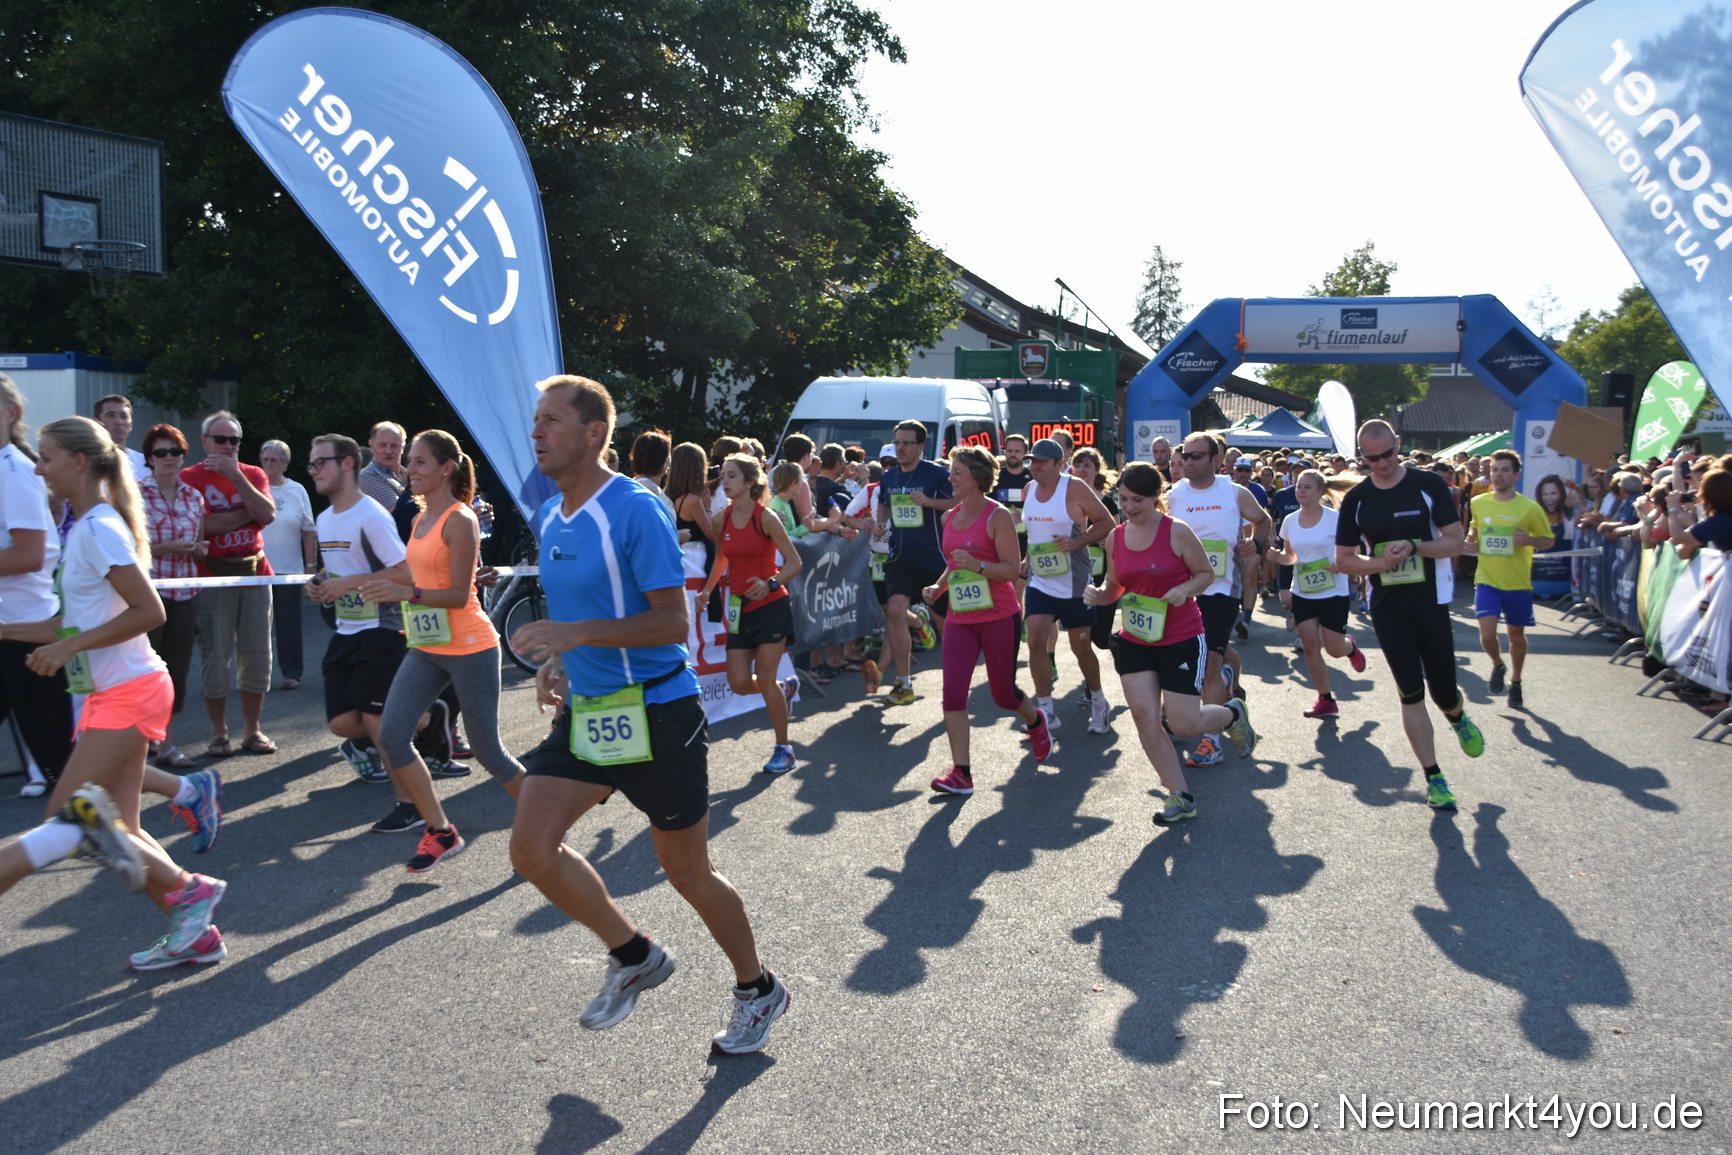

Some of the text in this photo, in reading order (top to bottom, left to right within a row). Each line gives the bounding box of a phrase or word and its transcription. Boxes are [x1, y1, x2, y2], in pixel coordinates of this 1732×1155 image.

[1326, 329, 1409, 344] firmenlauf
[1176, 358, 1219, 367] Fischer
[1665, 397, 1693, 425] AOK
[1636, 416, 1668, 448] AOK
[897, 507, 917, 519] 385
[1486, 537, 1508, 549] 659
[1037, 554, 1059, 568] 581
[1304, 571, 1328, 586] 123
[955, 584, 982, 601] 349
[413, 612, 441, 632] 131
[1129, 610, 1153, 631] 361
[587, 714, 633, 744] 556
